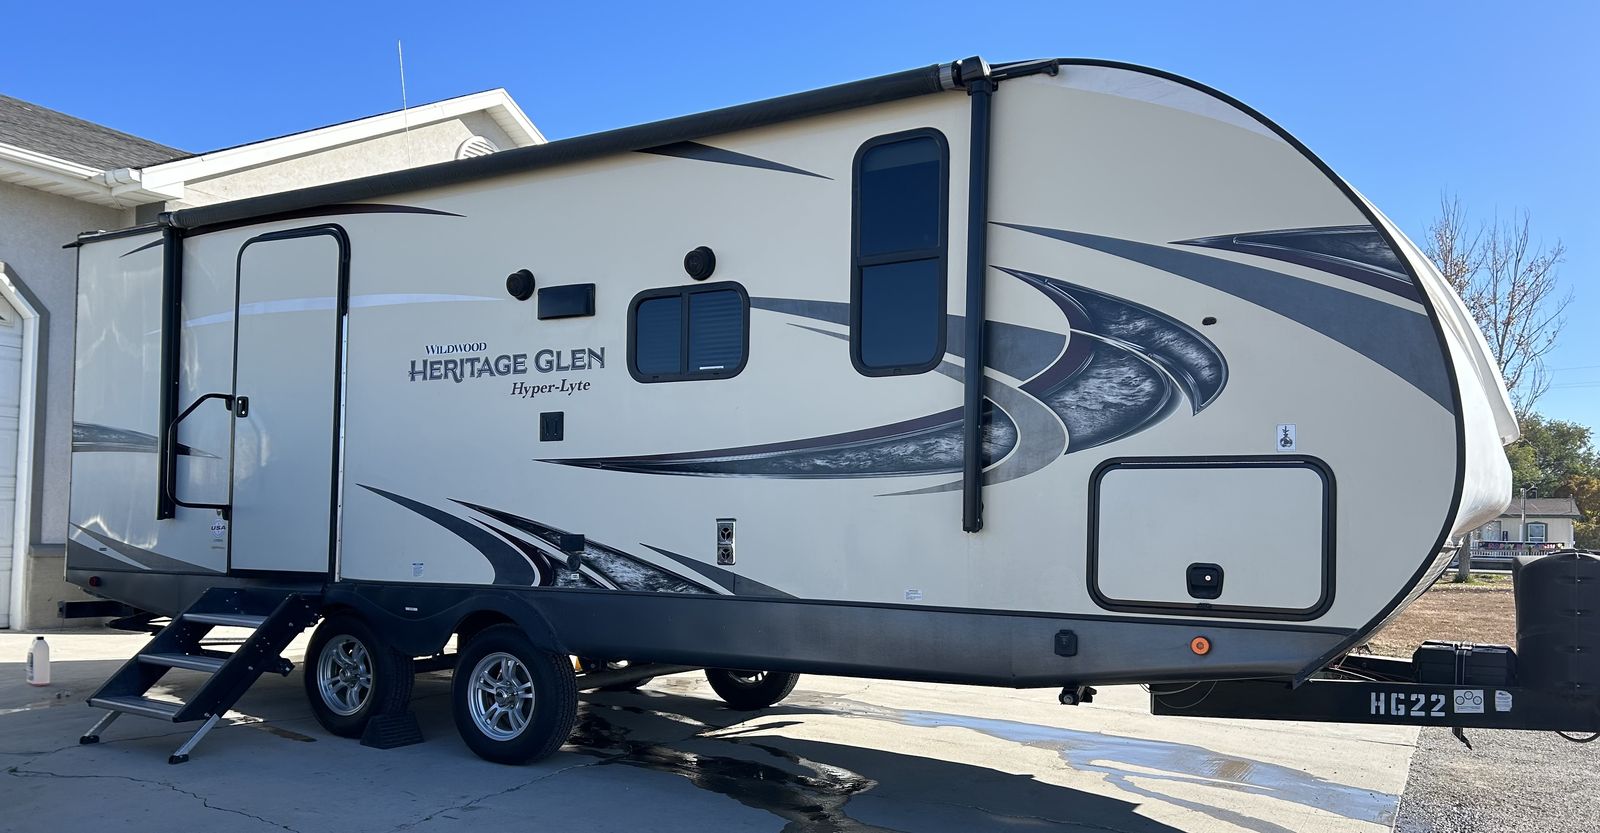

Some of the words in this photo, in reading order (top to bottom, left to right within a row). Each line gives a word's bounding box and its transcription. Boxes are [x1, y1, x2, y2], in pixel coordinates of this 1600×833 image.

[408, 354, 528, 383] HERITAGE
[534, 347, 606, 373] GLEN
[510, 379, 591, 398] Hyper-Lyte
[1370, 692, 1446, 717] HG22
